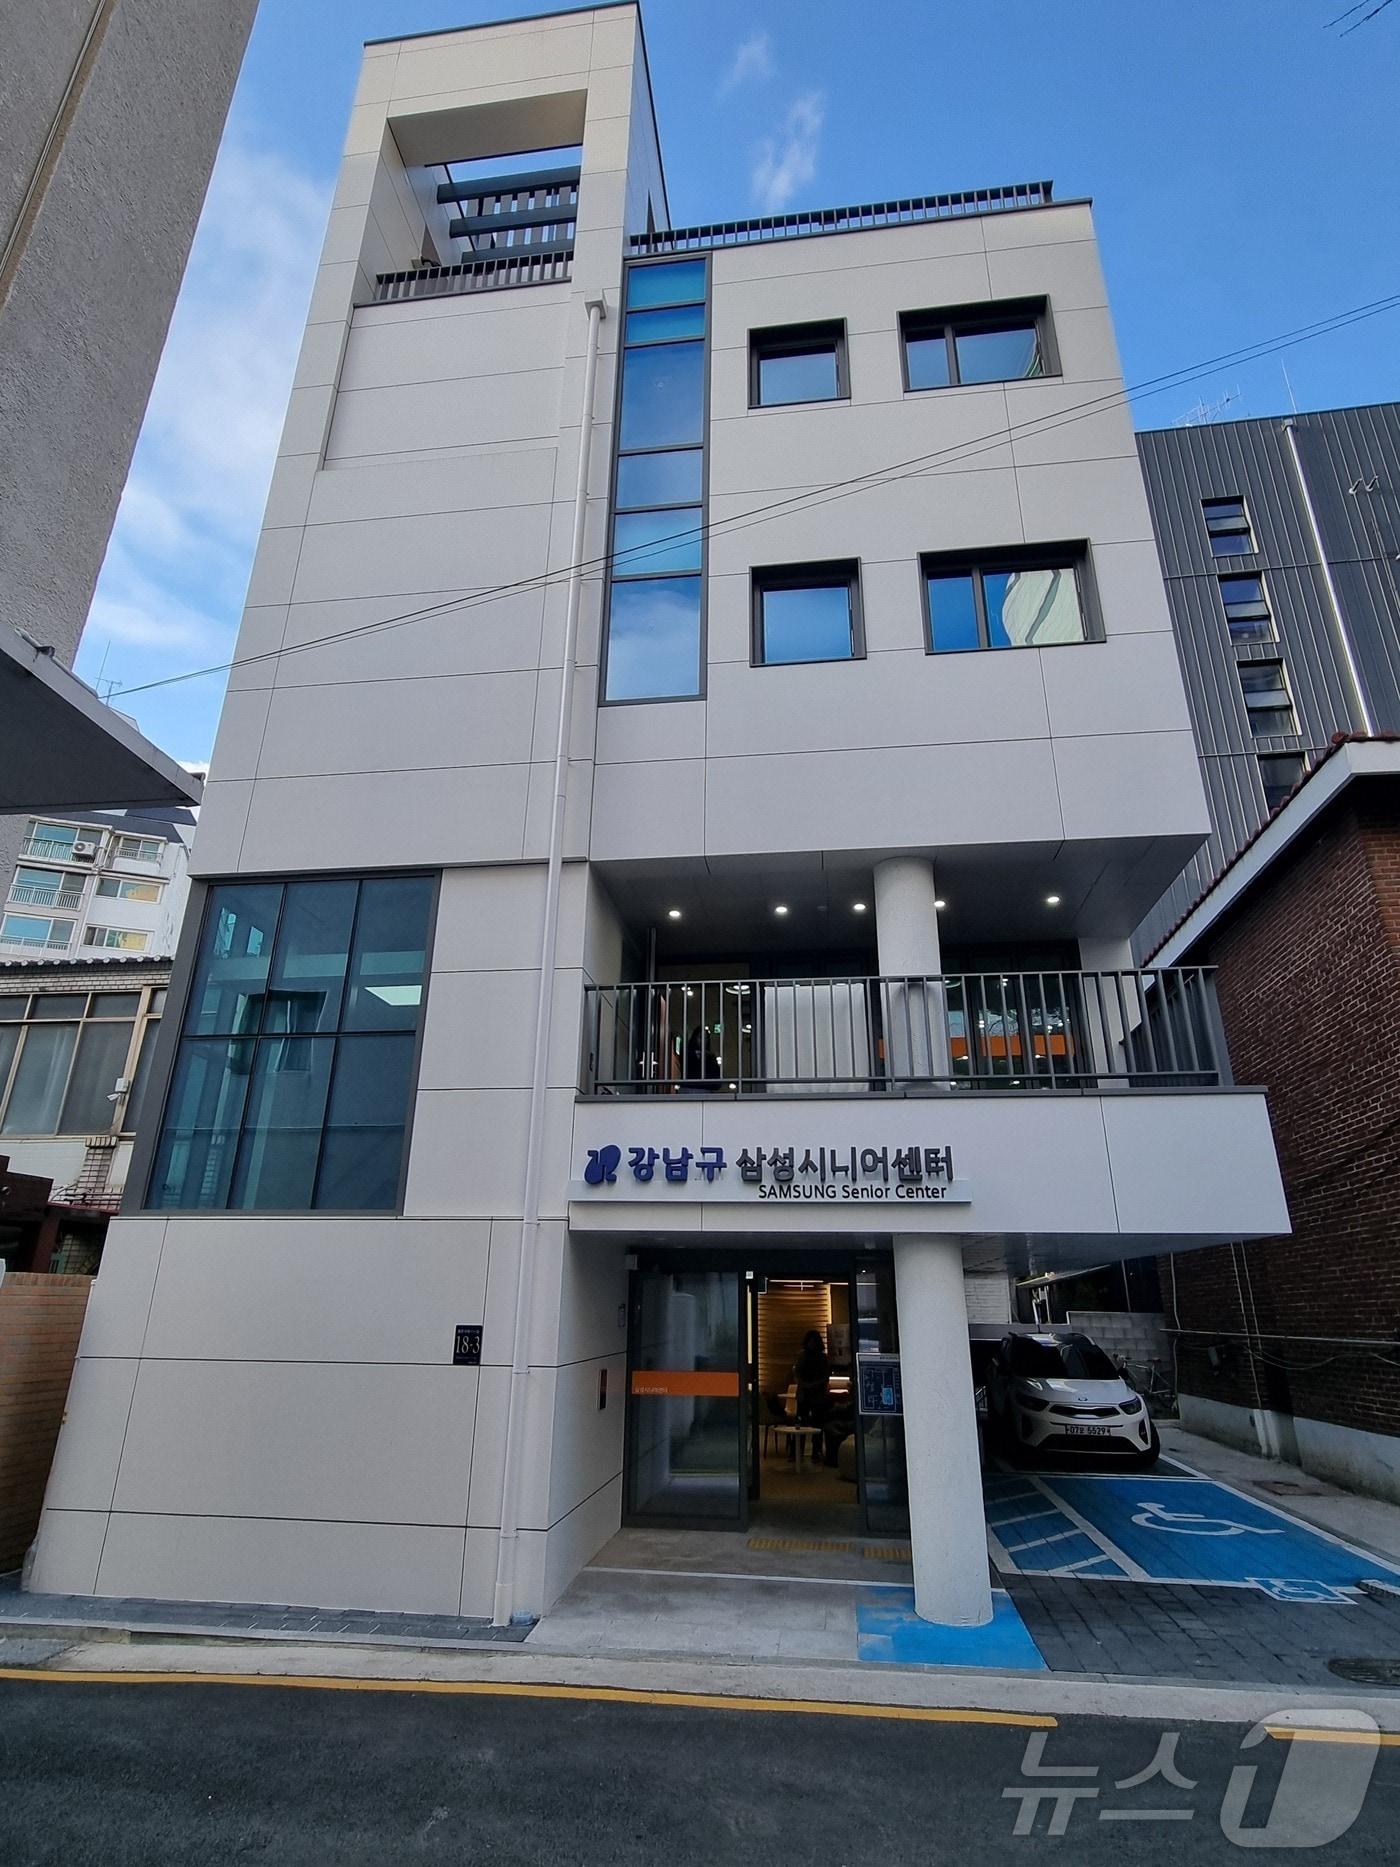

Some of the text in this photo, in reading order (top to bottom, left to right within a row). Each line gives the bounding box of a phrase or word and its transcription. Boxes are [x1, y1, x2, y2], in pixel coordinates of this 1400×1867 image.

[627, 1146, 954, 1183] 강남구 삼성시니어센터
[759, 1183, 947, 1199] SAMSUNG Senior Center
[456, 1335, 480, 1354] 18-3
